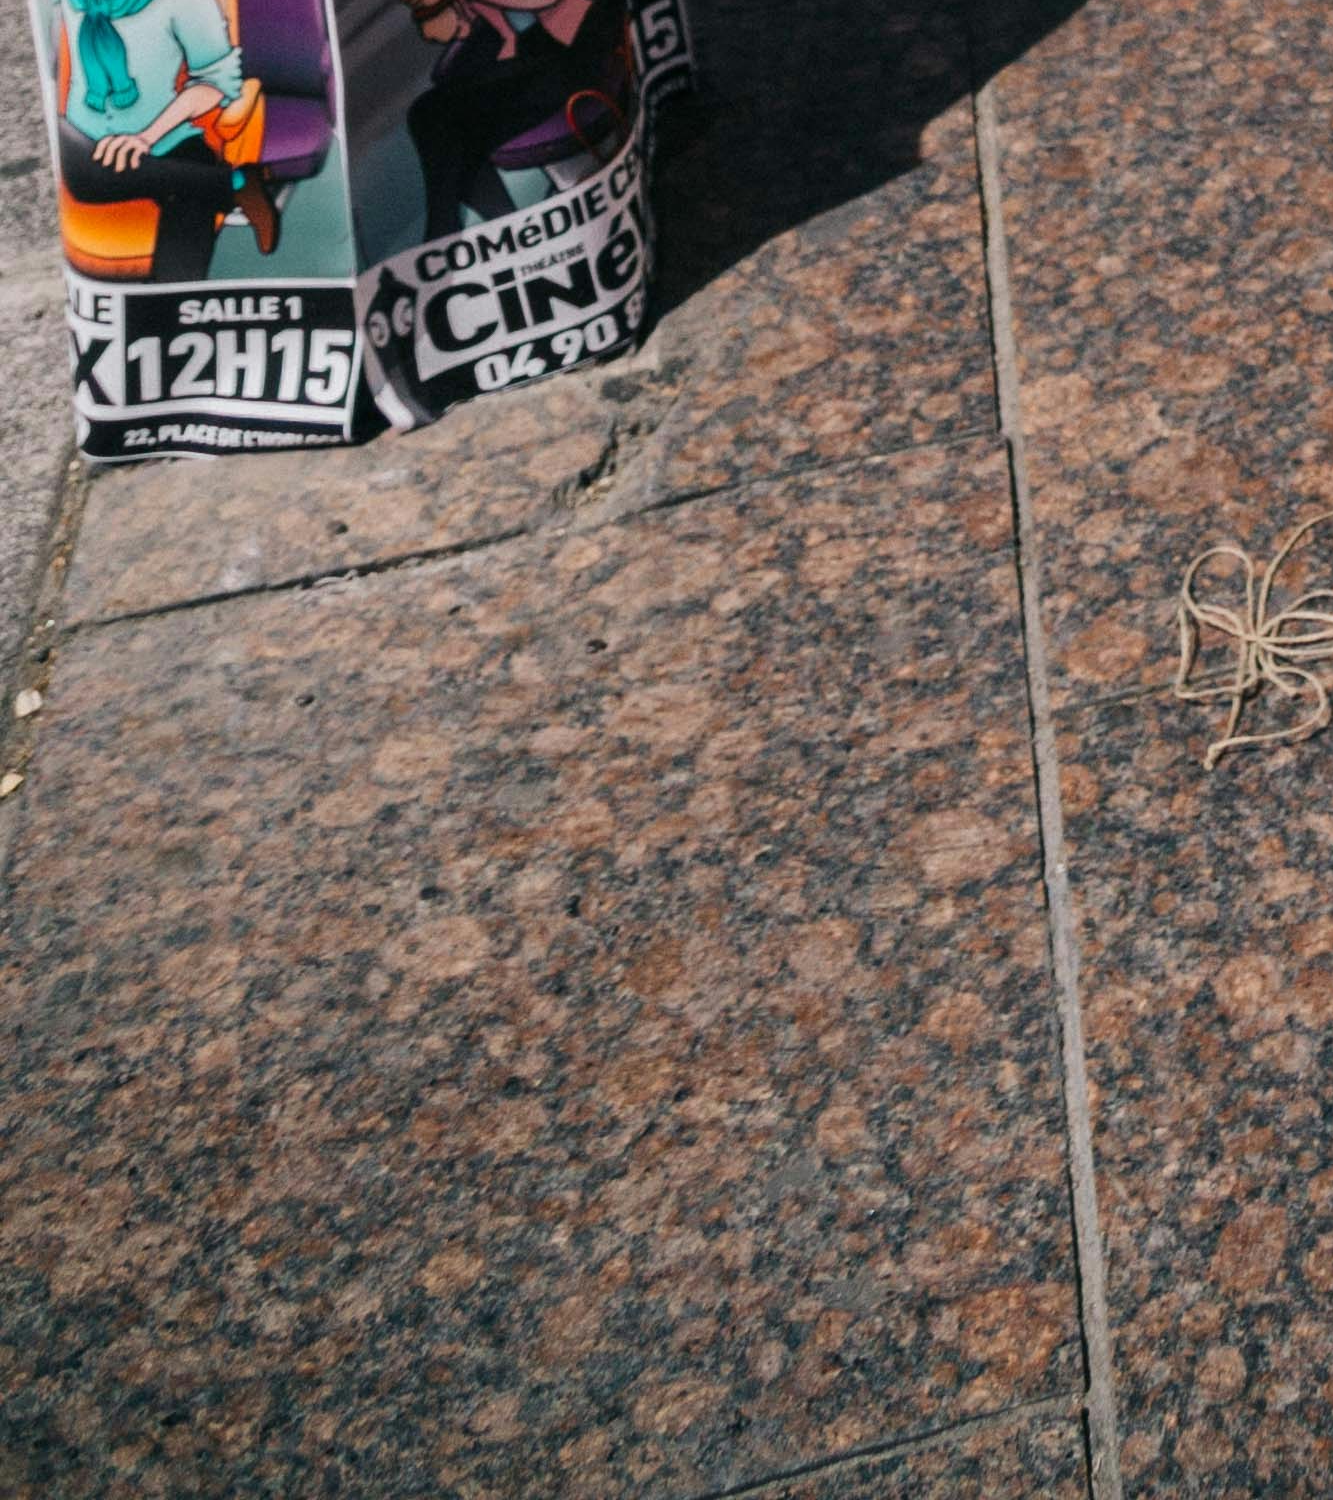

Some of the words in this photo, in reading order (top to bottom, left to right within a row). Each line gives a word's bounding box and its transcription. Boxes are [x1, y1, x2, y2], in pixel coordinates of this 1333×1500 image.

[178, 296, 281, 325] SALLE
[285, 296, 302, 320] 1
[127, 328, 354, 405] 12H15
[474, 348, 548, 392] 04
[550, 312, 619, 368] 90
